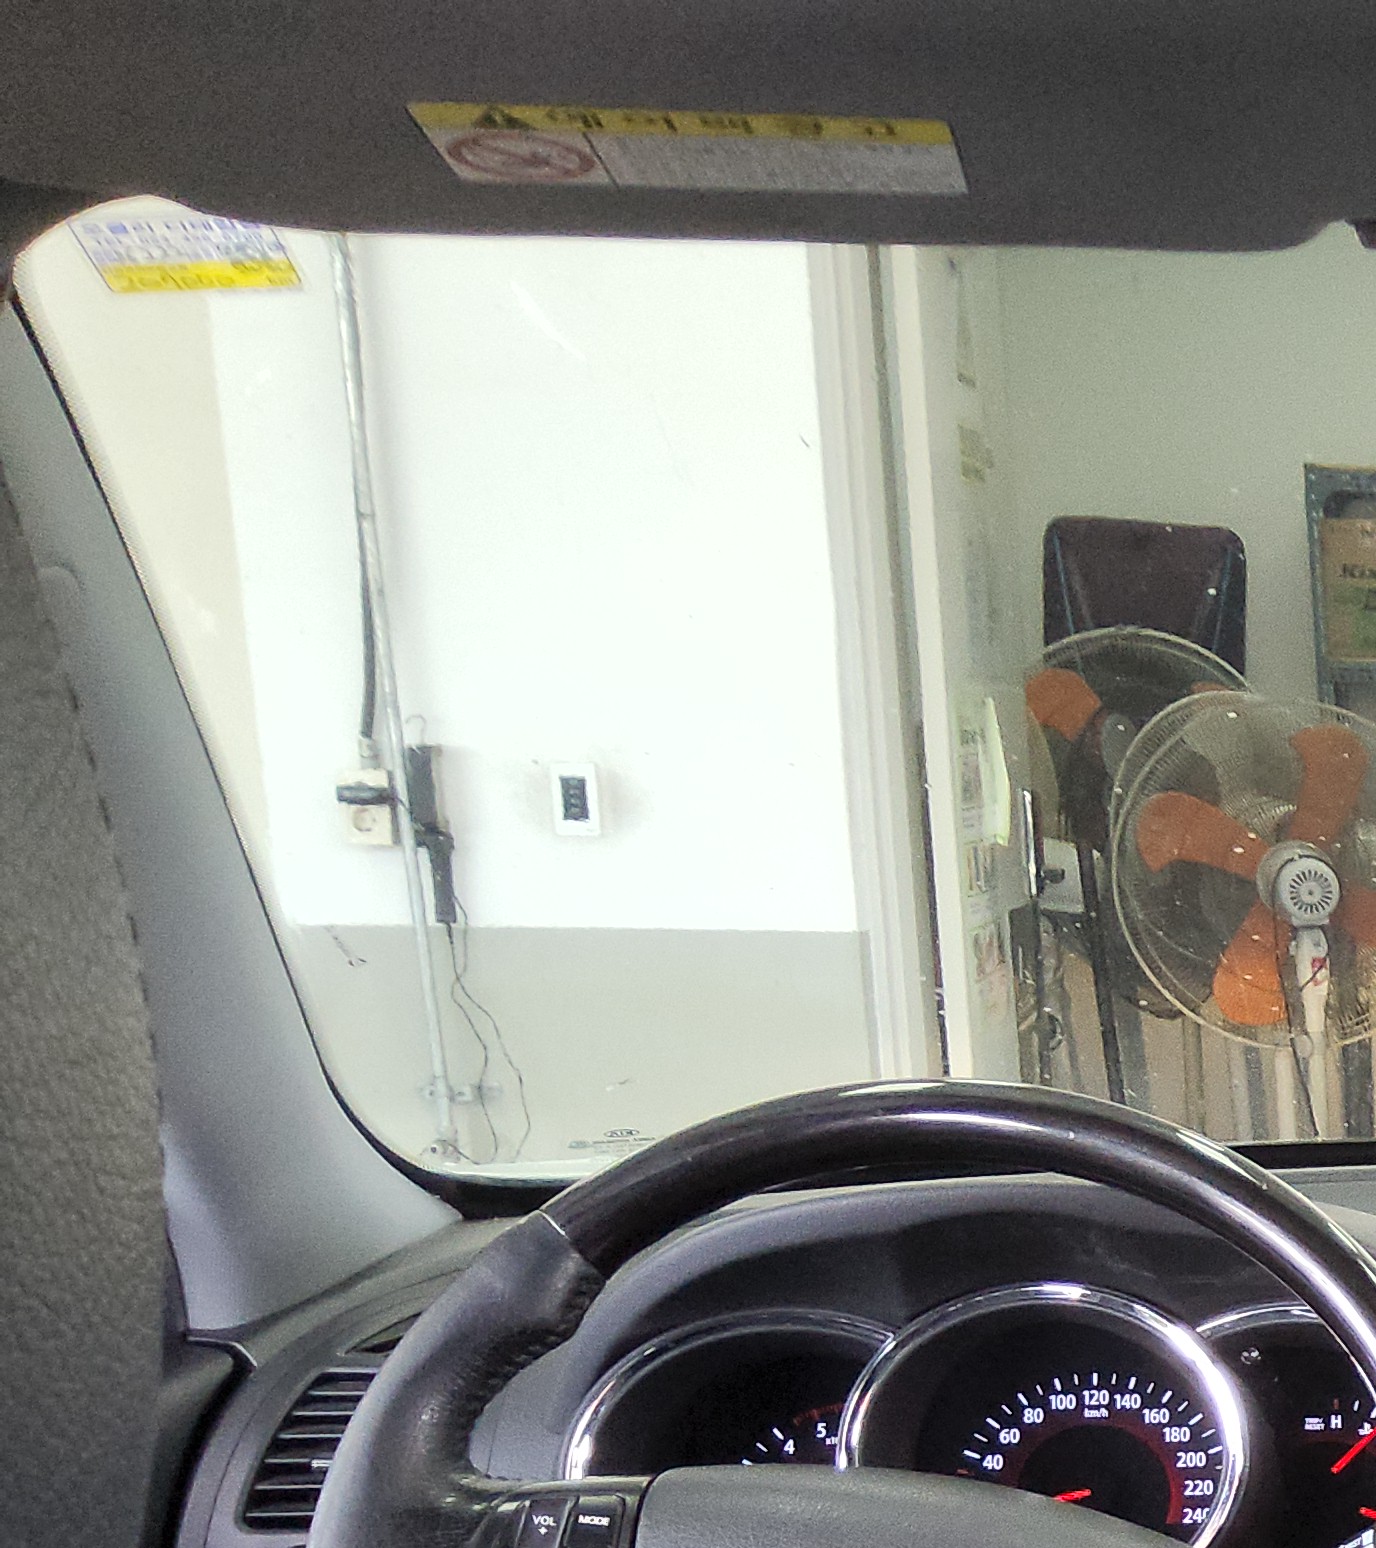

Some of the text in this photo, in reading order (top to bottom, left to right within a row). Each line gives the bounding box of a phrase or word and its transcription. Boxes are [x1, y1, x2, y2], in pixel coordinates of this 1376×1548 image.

[1049, 1394, 1077, 1410] 100
[1083, 1390, 1109, 1405] 120
[1114, 1394, 1141, 1410] 140
[1023, 1408, 1044, 1424] 80
[1084, 1408, 1109, 1418] km/h
[1143, 1409, 1170, 1424] 160
[1330, 1414, 1342, 1429] H
[816, 1422, 827, 1438] 5
[1000, 1428, 1020, 1444] 60
[1163, 1427, 1191, 1443] 180
[783, 1439, 796, 1455] 4
[983, 1455, 1004, 1471] 40
[1176, 1452, 1206, 1468] 200
[1184, 1480, 1213, 1496] 220
[532, 1514, 557, 1527] VOL
[578, 1514, 611, 1527] MODE
